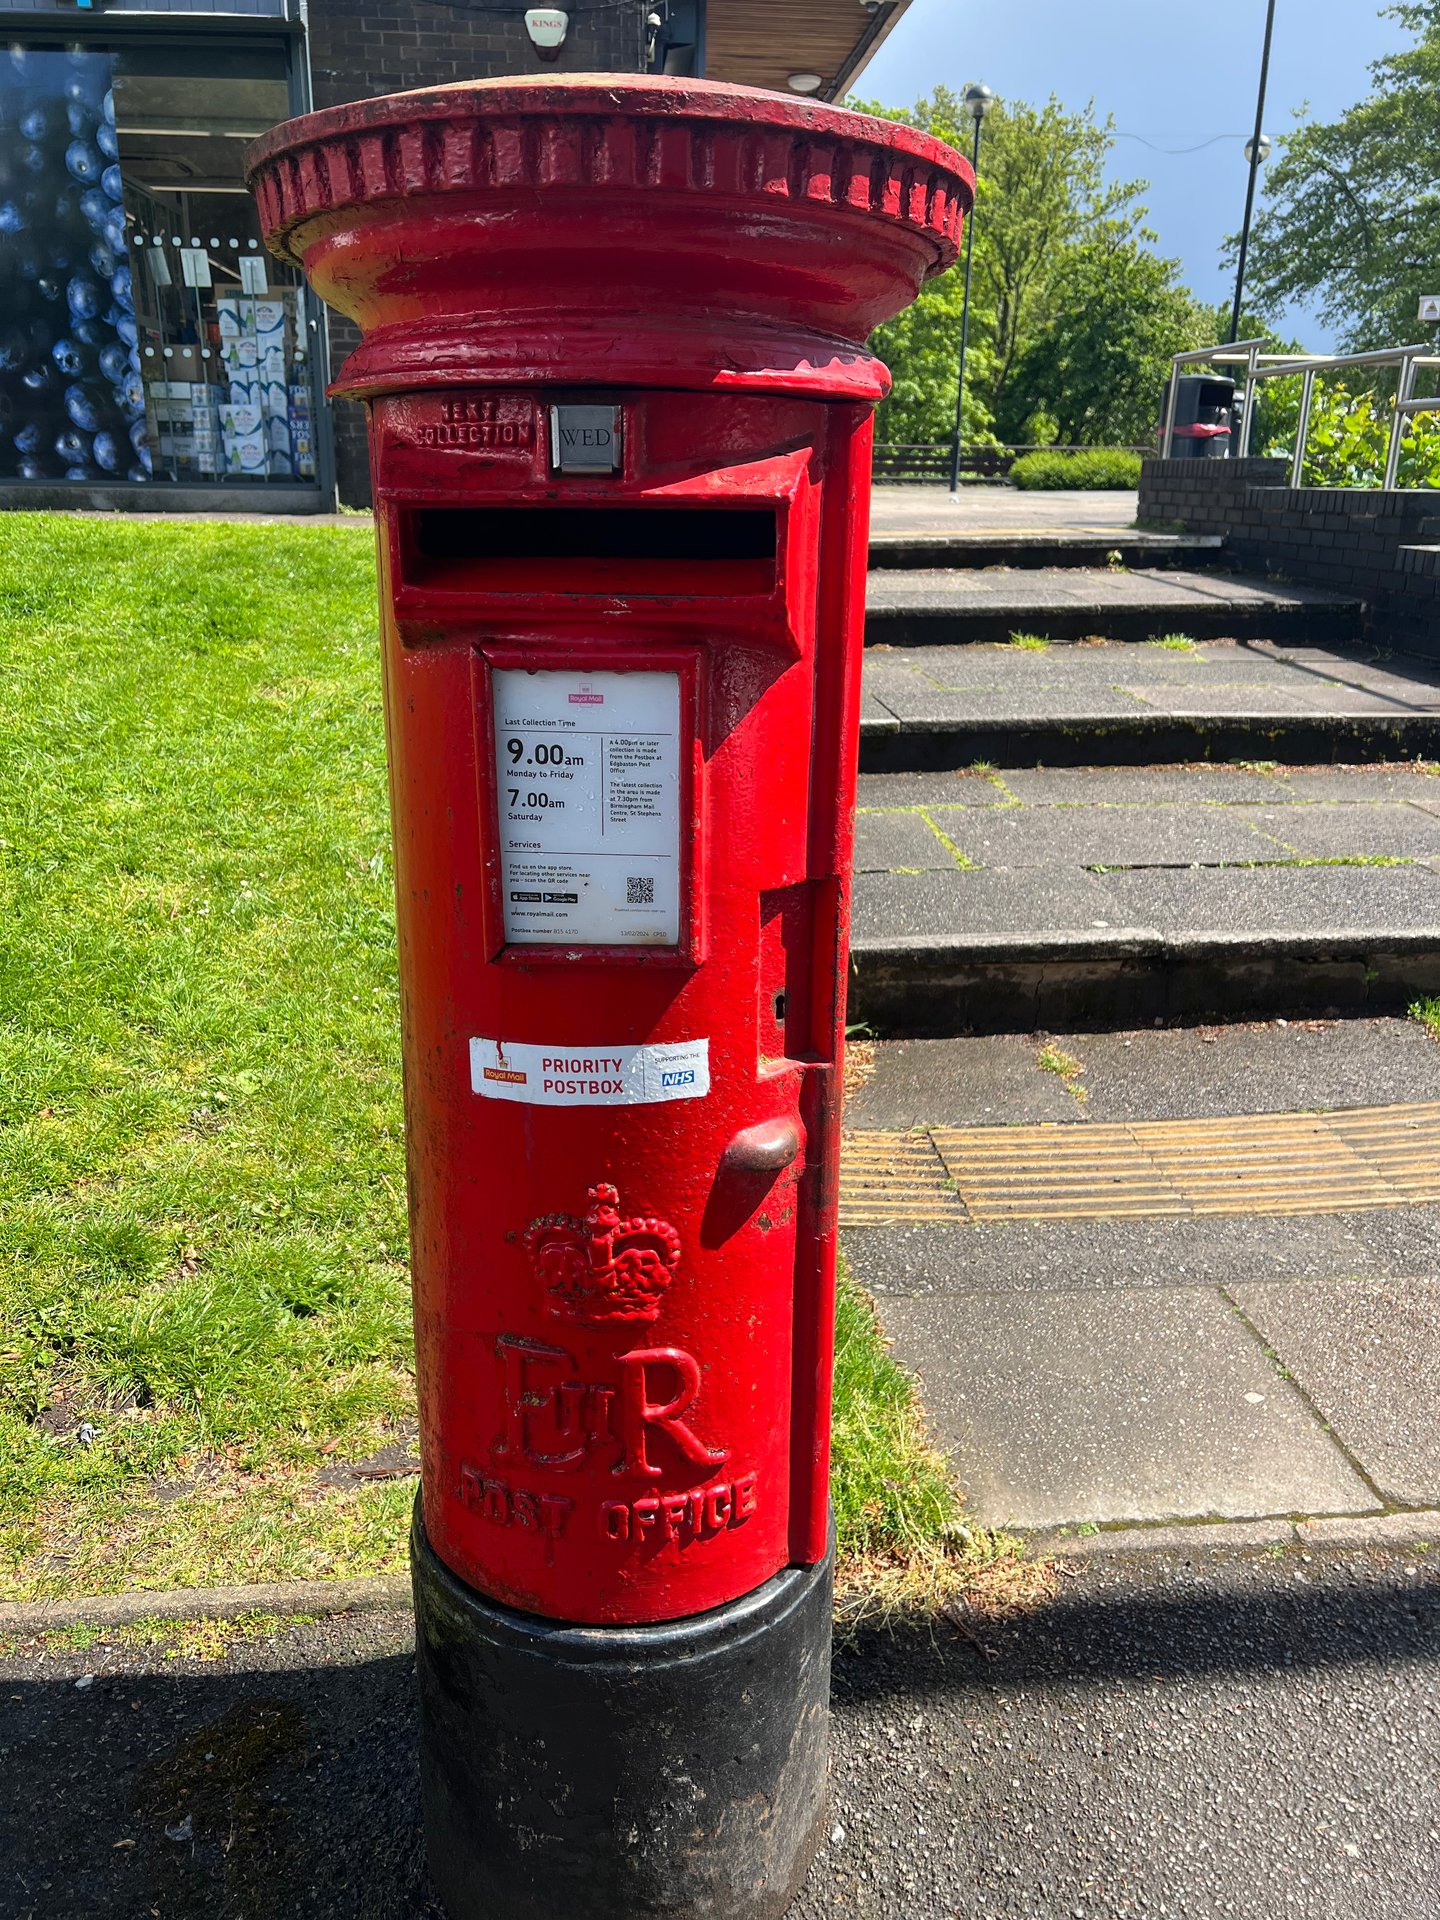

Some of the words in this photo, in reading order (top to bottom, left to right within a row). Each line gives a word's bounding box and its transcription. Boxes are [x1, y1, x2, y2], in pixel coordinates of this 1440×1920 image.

[532, 19, 562, 28] KINGS
[416, 424, 529, 445] COLLECTION
[560, 428, 611, 447] WED
[507, 738, 584, 766] 9.00am
[506, 769, 537, 779] Monday
[550, 770, 574, 780] Friday
[507, 788, 565, 809] 7.00am
[617, 795, 638, 803] 7.30pm
[508, 812, 543, 822] Saturday
[508, 840, 541, 849] Services
[542, 1058, 622, 1073] PRIORITY
[655, 1054, 689, 1064] SUPPORTING
[485, 1068, 506, 1080] Royal
[506, 1071, 525, 1081] Mail
[663, 1071, 693, 1086] NHS
[543, 1079, 624, 1094] POSTBOX
[457, 1462, 576, 1540] POST
[601, 1471, 758, 1543] OFFICE
